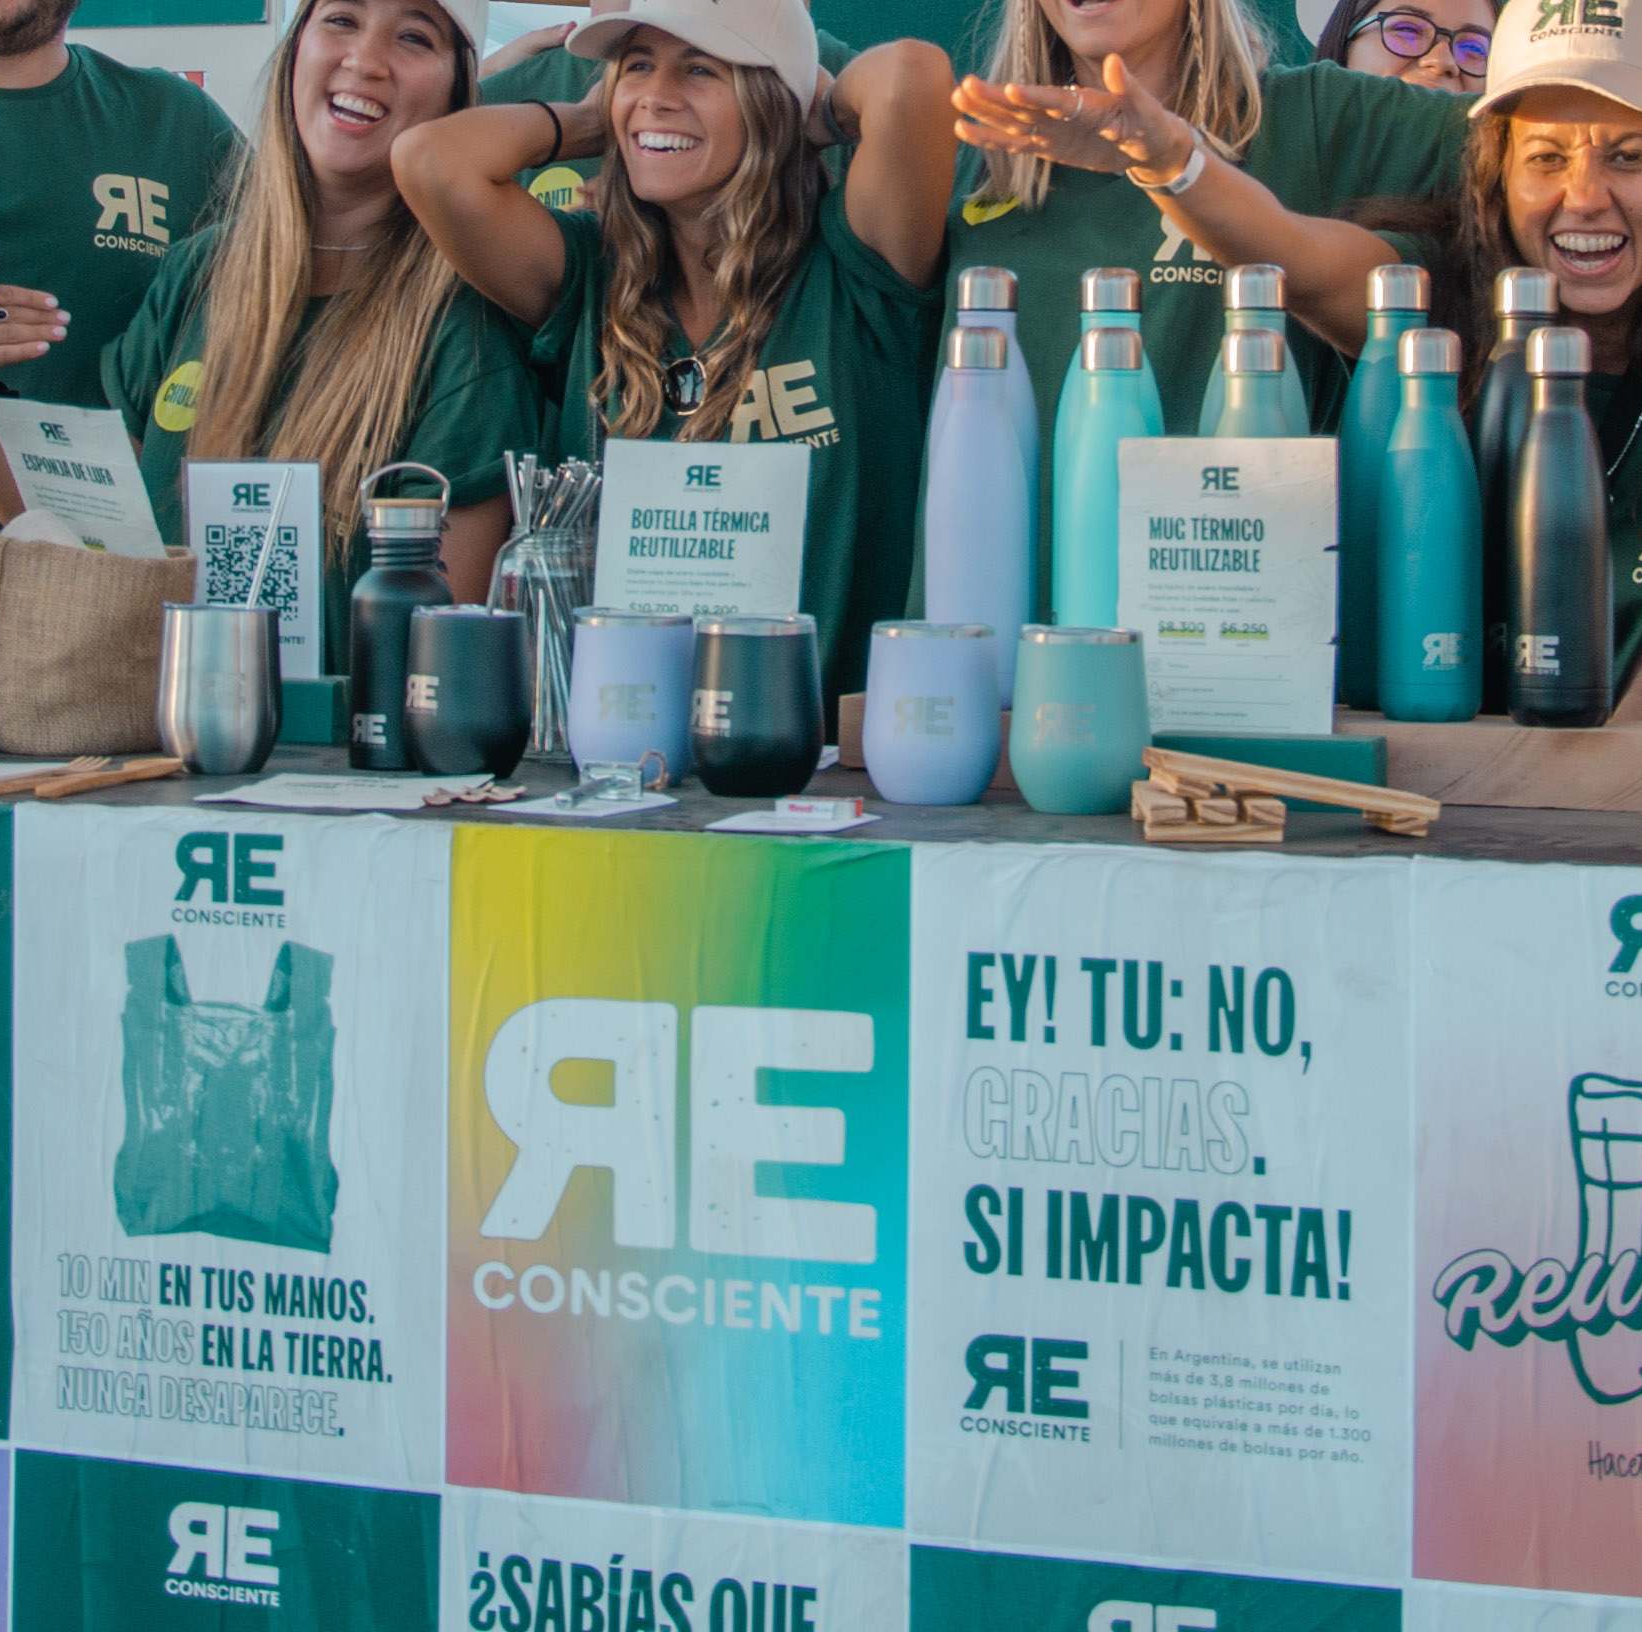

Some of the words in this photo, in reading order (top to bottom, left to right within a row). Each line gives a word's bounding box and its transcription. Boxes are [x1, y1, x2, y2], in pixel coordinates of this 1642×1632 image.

[1529, 25, 1623, 43] CONSCIENTE
[94, 234, 170, 258] CONSCIENT
[22, 453, 73, 478] ESPONJA
[73, 462, 87, 480] DE
[88, 465, 116, 487] LUFA
[631, 509, 696, 531] BOTELLA
[703, 508, 770, 532] TÉRMICA
[1149, 517, 1185, 540] MUG
[1191, 515, 1264, 541] TÉRMICO
[629, 537, 735, 560] REUTILIZABLE
[1149, 548, 1260, 572] REUTILIZABLE
[171, 908, 287, 929] CONSCIENTE
[966, 951, 1057, 1044] EY!
[1080, 957, 1183, 1051] TU:
[1208, 964, 1312, 1075] NO,
[963, 1066, 1267, 1176] GRACIAS.
[963, 1183, 1024, 1277] SI
[1046, 1189, 1352, 1301] IMPACTA!
[57, 1253, 92, 1298] 10
[99, 1257, 151, 1304] MIN
[159, 1263, 191, 1308] EN
[202, 1266, 254, 1312] TUS
[265, 1273, 375, 1324] MANOS.
[473, 1260, 882, 1340] CONSCIENTE
[57, 1309, 109, 1356] 150
[117, 1309, 195, 1364] AÑOS
[202, 1324, 234, 1368] EN
[242, 1327, 275, 1372] LA
[284, 1331, 393, 1383] TIERRA.
[1149, 1347, 1168, 1361] En
[1174, 1349, 1256, 1369] Argentina,
[1261, 1359, 1278, 1370] se
[1283, 1359, 1341, 1375] utilizan
[1149, 1370, 1180, 1383] más
[1185, 1373, 1205, 1385] de
[1209, 1374, 1234, 1389] 3,8
[1239, 1377, 1305, 1394] millones
[1310, 1382, 1330, 1395] de
[57, 1366, 152, 1417] NUNCA
[159, 1376, 345, 1437] DESAPARECE.
[1149, 1389, 1198, 1406] bolsas
[1203, 1396, 1272, 1413] plásticas
[1279, 1403, 1304, 1416] por
[1344, 1407, 1360, 1419] lo
[960, 1415, 1091, 1443] CONSCIENTE
[1149, 1414, 1177, 1427] que
[1183, 1416, 1248, 1432] equivale
[1253, 1422, 1262, 1432] a
[1268, 1422, 1299, 1437] más
[1304, 1425, 1323, 1438] de
[1329, 1427, 1371, 1442] 1.300
[1149, 1434, 1213, 1450] millones
[1219, 1439, 1238, 1452] de
[1243, 1441, 1293, 1458] bolsas
[1299, 1448, 1325, 1461] por
[1330, 1450, 1364, 1463] año.
[164, 1578, 281, 1608] CONSCIENTE
[468, 1551, 694, 1632] ¿SABÍAS
[710, 1578, 818, 1632] QUE
